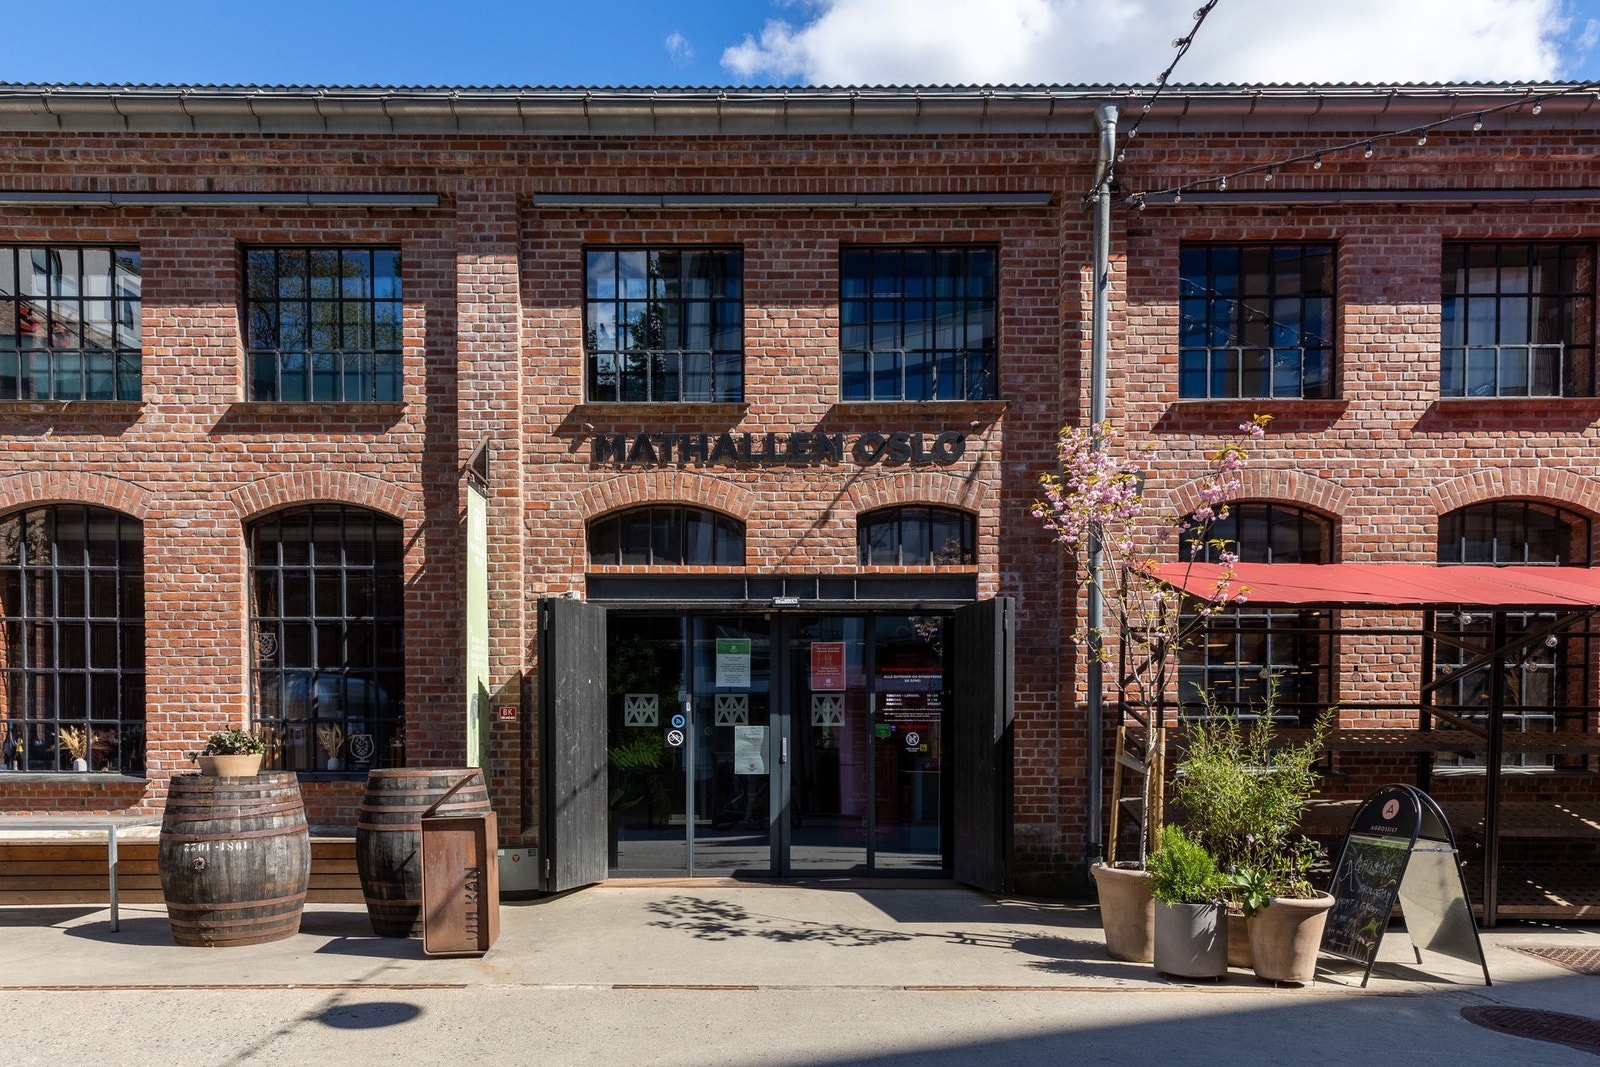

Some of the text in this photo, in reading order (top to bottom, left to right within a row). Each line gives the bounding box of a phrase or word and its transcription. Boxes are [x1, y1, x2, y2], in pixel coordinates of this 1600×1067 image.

[594, 431, 966, 462] MATHALLEN OSLO
[502, 708, 513, 716] BK
[1386, 804, 1394, 815] A
[463, 867, 481, 942] VULKAN
